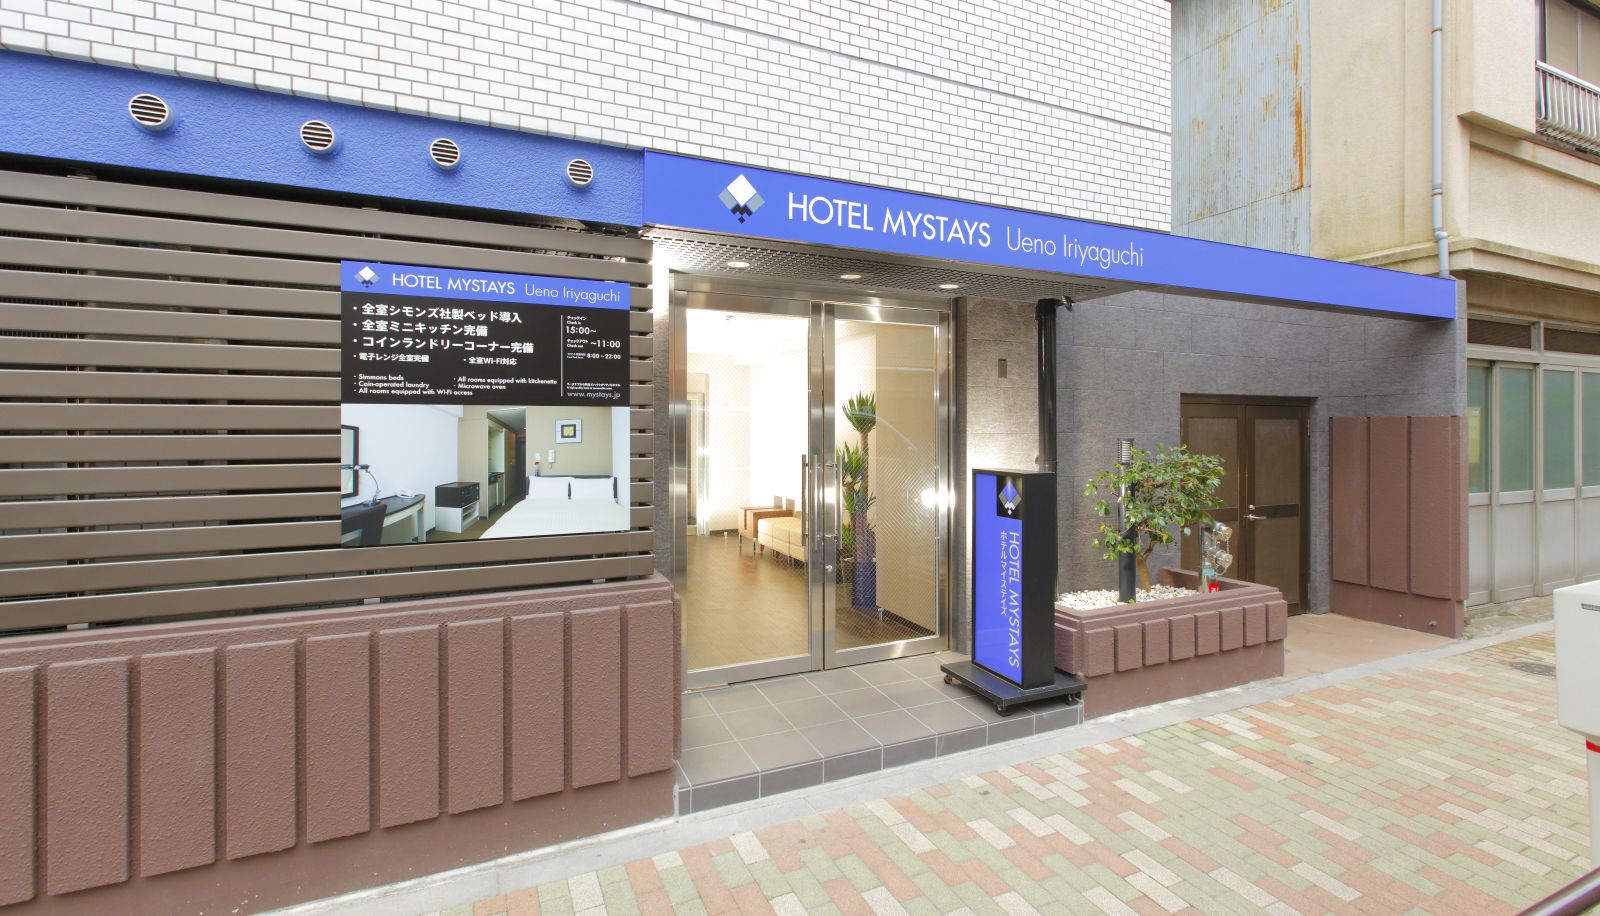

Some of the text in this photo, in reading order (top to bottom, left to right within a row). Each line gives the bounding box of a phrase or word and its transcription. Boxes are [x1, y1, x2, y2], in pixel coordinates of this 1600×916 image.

[787, 191, 1145, 270] HOTEL MYSTAYS Ueno Iriyaguchi
[391, 272, 621, 304] HOTEL MYSTAYS Ueno Iriyaguchi
[361, 302, 523, 324] 全室シモンズ社製ベッド導入
[361, 319, 489, 337] 全室ミニキッチン完備
[362, 336, 535, 354] コインランドリーコーナー完備
[359, 352, 430, 363] 電子レンジ全室完備
[358, 373, 387, 381] Simmons
[358, 380, 430, 390] Coin-operated laundry
[1008, 531, 1020, 669] HOTEL MYSTAYS
